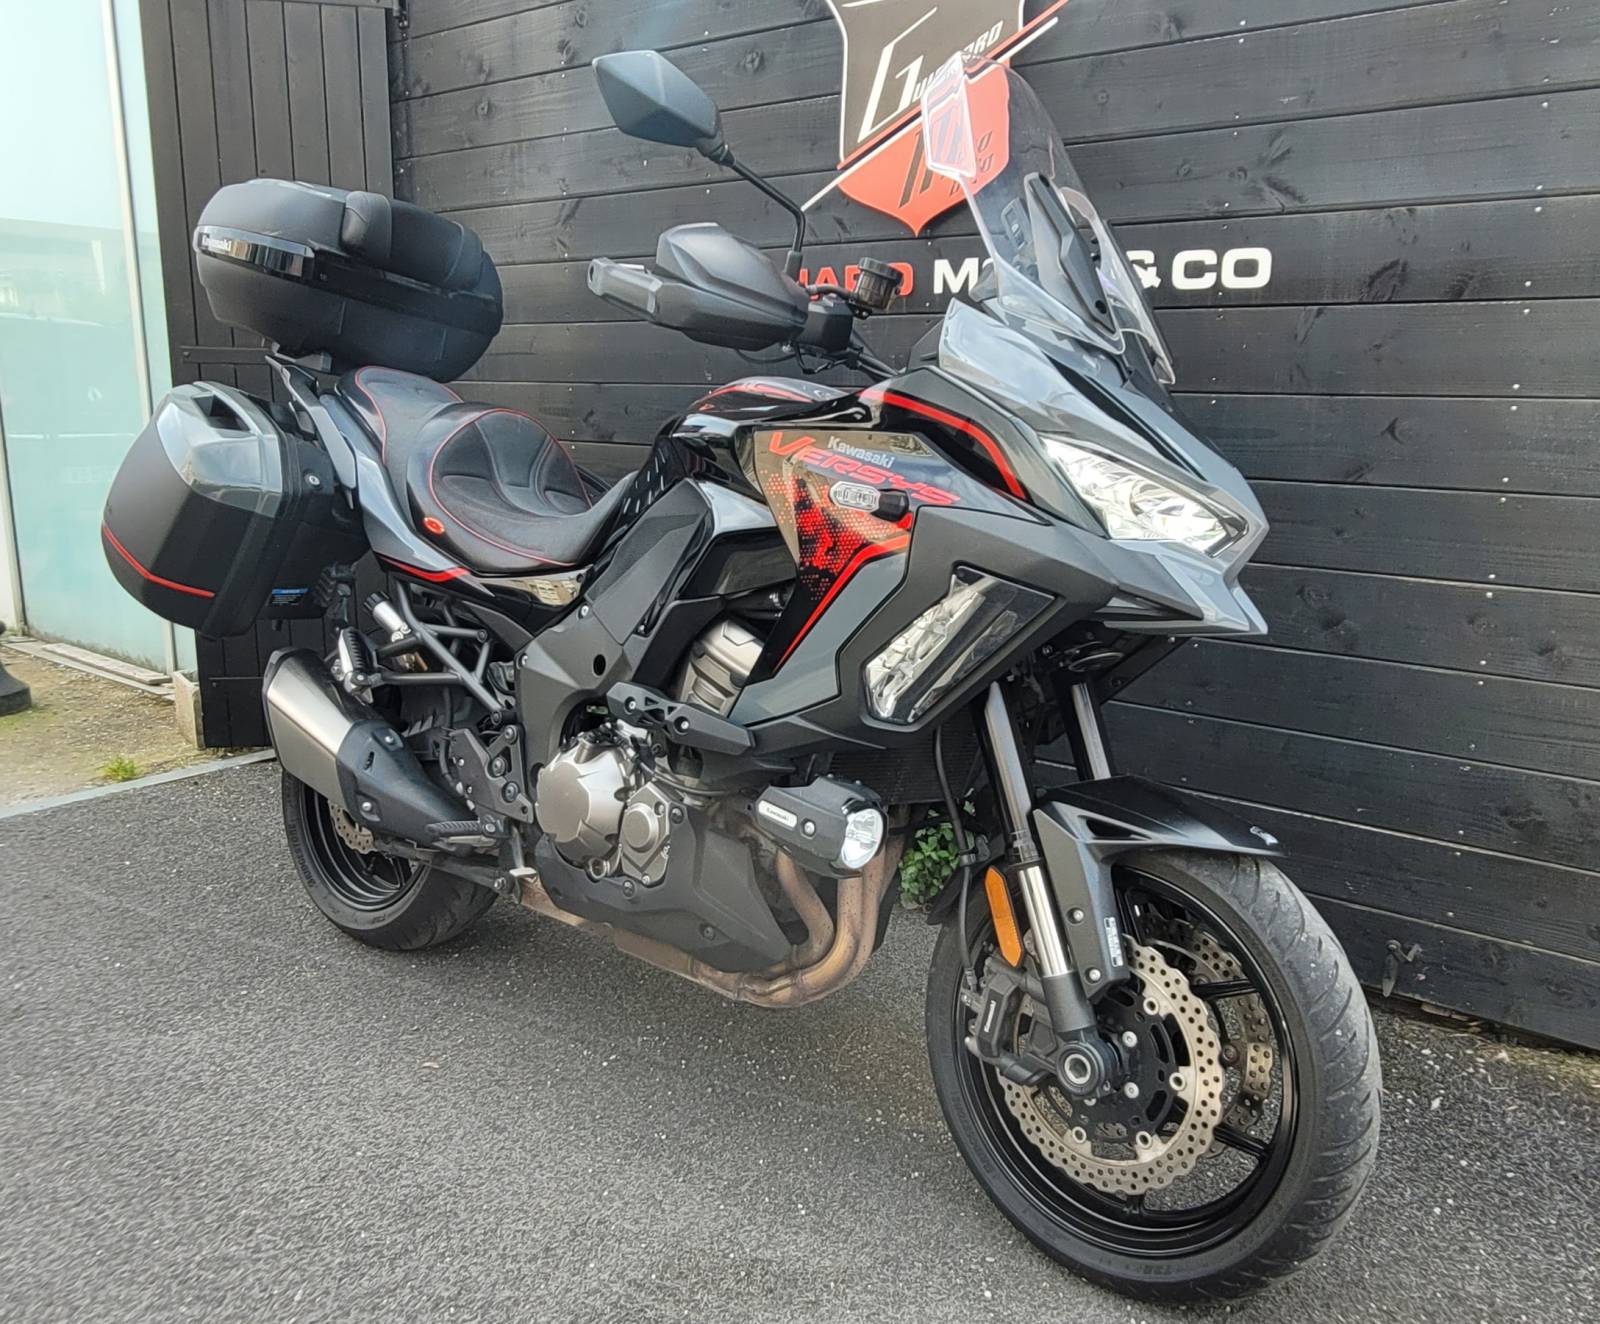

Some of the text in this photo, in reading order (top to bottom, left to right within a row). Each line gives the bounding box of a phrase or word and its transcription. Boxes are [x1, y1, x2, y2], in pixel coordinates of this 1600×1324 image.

[1171, 247, 1273, 291] CO
[768, 431, 961, 505] VERSYS
[828, 436, 894, 469] Kawasaki
